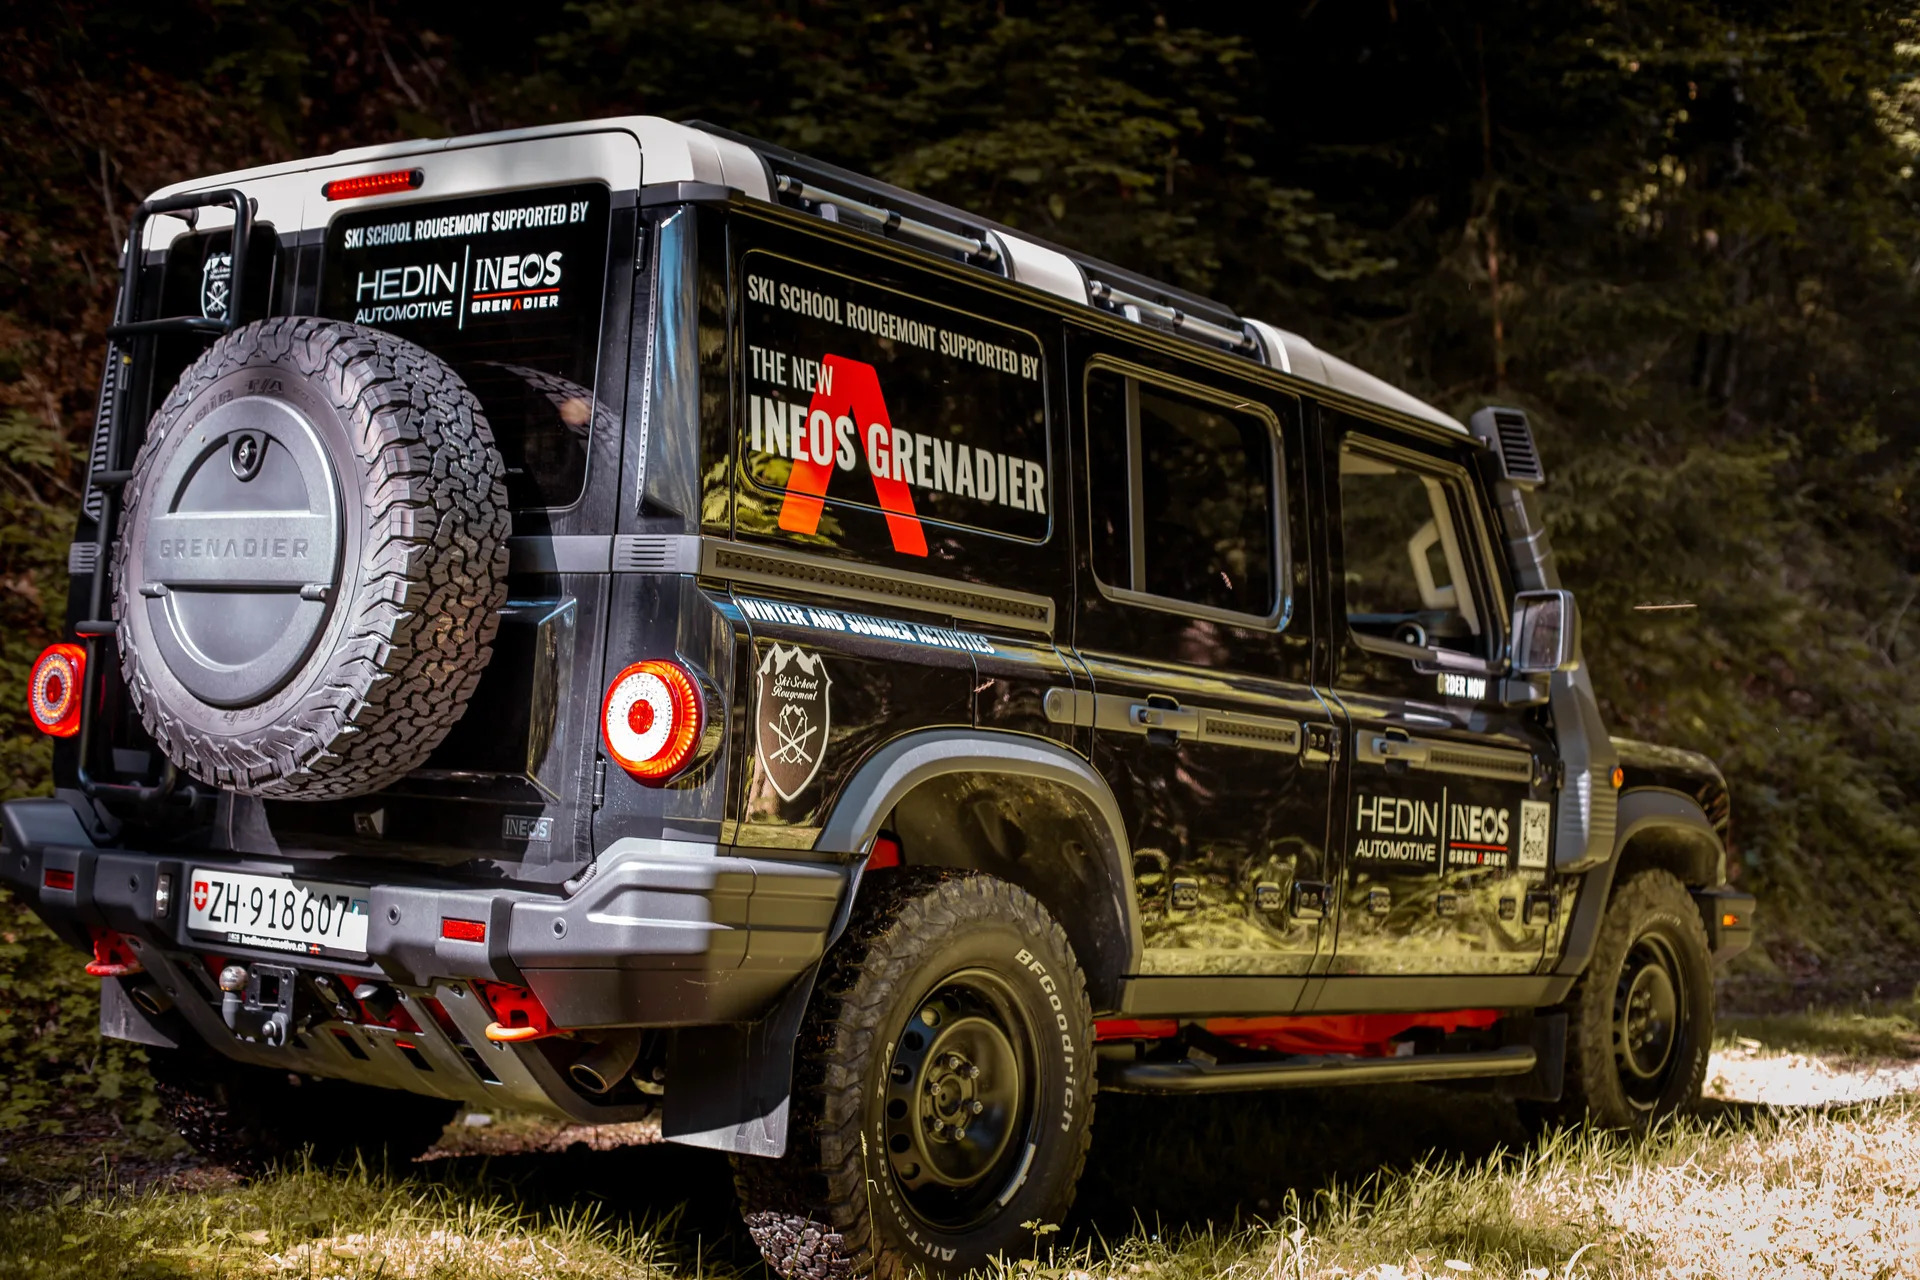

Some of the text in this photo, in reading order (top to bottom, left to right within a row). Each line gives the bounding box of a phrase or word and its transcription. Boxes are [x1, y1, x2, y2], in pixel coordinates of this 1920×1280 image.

[344, 201, 590, 249] SKI SCHOOL ROUGEMONT SUPPORTED BY
[356, 262, 458, 302] HEDIN
[473, 251, 563, 292] INEOS
[354, 300, 453, 324] AUTOMOTIVE
[471, 295, 559, 314] GRENADIER
[748, 274, 1039, 381] SKI SCHOOL ROUGEMONT SUPPORTED BY
[749, 345, 833, 396] THE NEW
[750, 394, 1047, 515] INEOS GRENADIER
[158, 537, 310, 560] GRENADIER
[739, 598, 996, 654] WINTER AND SUMMER ACTIVITIES
[771, 685, 818, 702] Rougemont
[774, 673, 819, 690] Ski School
[1437, 672, 1486, 700] ORDER NOW
[505, 818, 548, 838] INEOS
[1356, 794, 1438, 838] HEDIN
[1450, 803, 1510, 845] INEOS
[1355, 838, 1437, 862] AUTOMOTIVE
[1014, 948, 1075, 1133] BFGoodrich
